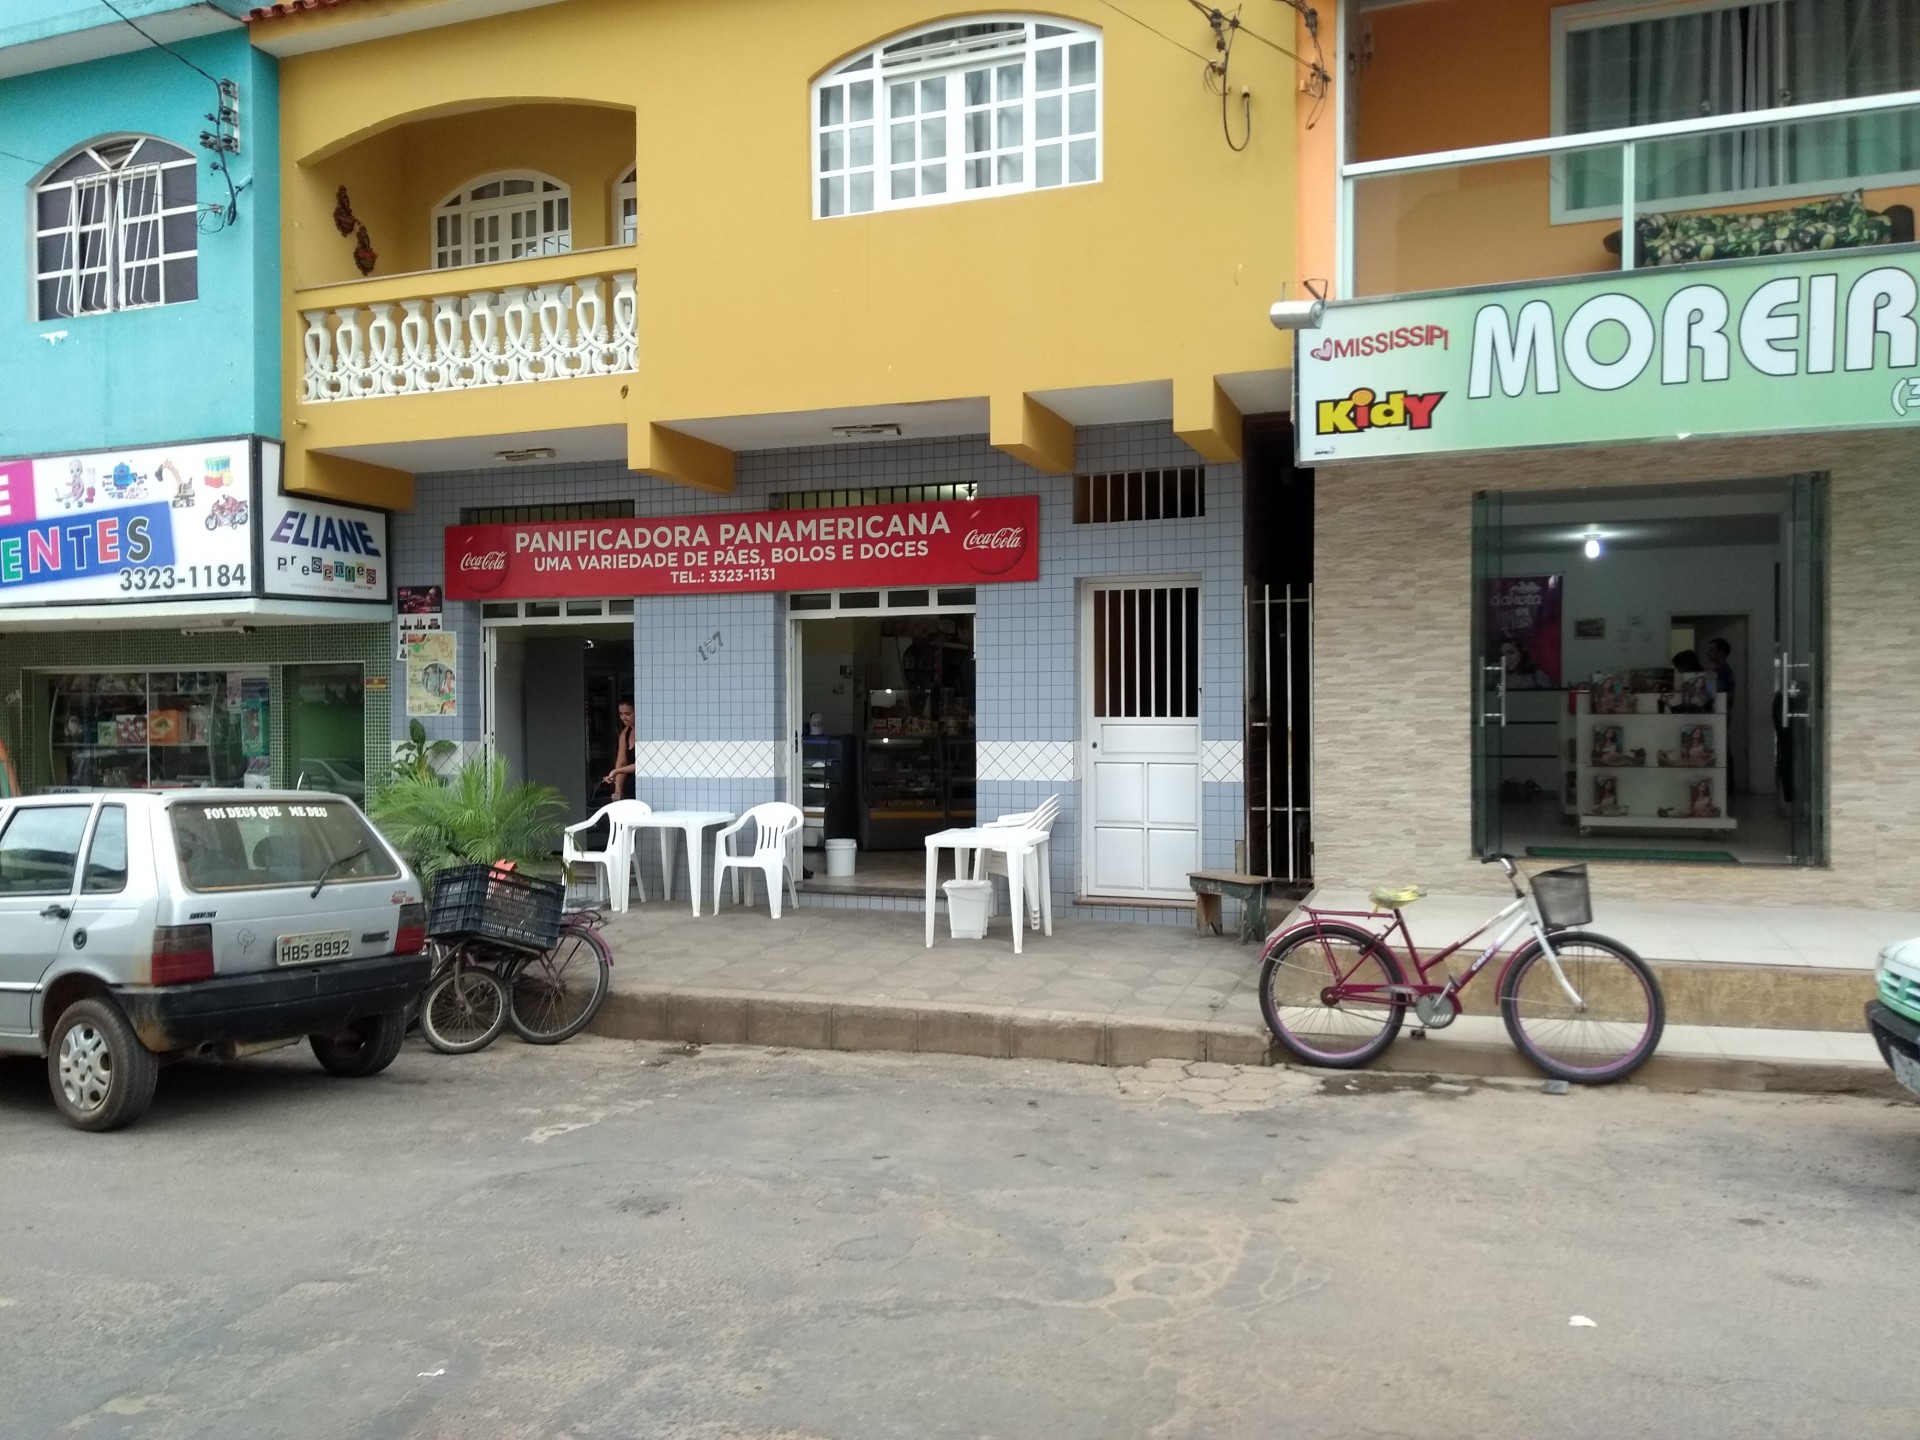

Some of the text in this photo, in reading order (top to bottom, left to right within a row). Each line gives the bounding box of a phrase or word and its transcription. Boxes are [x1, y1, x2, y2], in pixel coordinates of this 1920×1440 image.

[1467, 266, 1919, 399] MOREIR
[270, 510, 381, 557] ELIANE
[515, 511, 951, 553] PANIFICADORA PANAMERICANA
[962, 526, 1025, 550] Coca-Cola
[0, 516, 152, 583] ENTES
[460, 551, 507, 571] Coca-Cola
[534, 540, 929, 571] UMA VARIEDADE DE PÃES, BOLOS E DOCES
[119, 563, 247, 591] 3323-1184
[670, 567, 776, 584] TEL.: 3323-1131
[698, 630, 724, 661] 157
[203, 805, 328, 820] FOI DEUS QUE ME DEU
